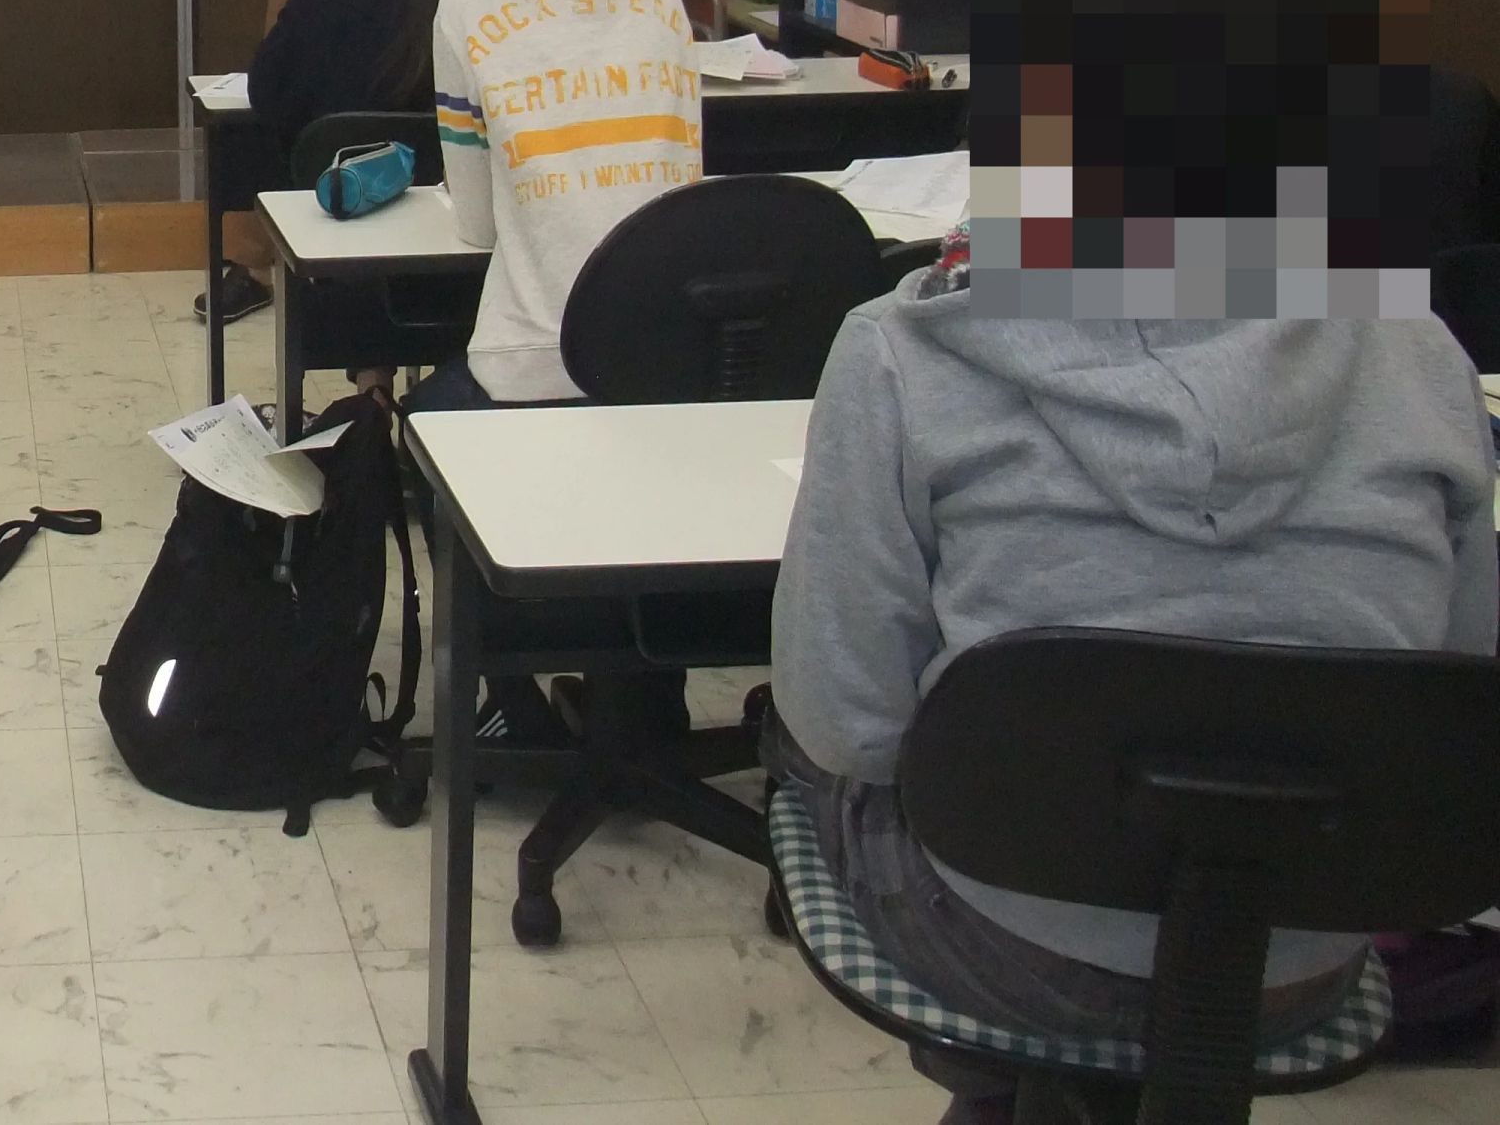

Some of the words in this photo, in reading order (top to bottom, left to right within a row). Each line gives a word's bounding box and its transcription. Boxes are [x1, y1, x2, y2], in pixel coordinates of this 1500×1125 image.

[482, 64, 629, 119] CERTAIN
[514, 173, 569, 204] STUFF
[596, 161, 655, 188] WANT
[660, 161, 681, 182] TO
